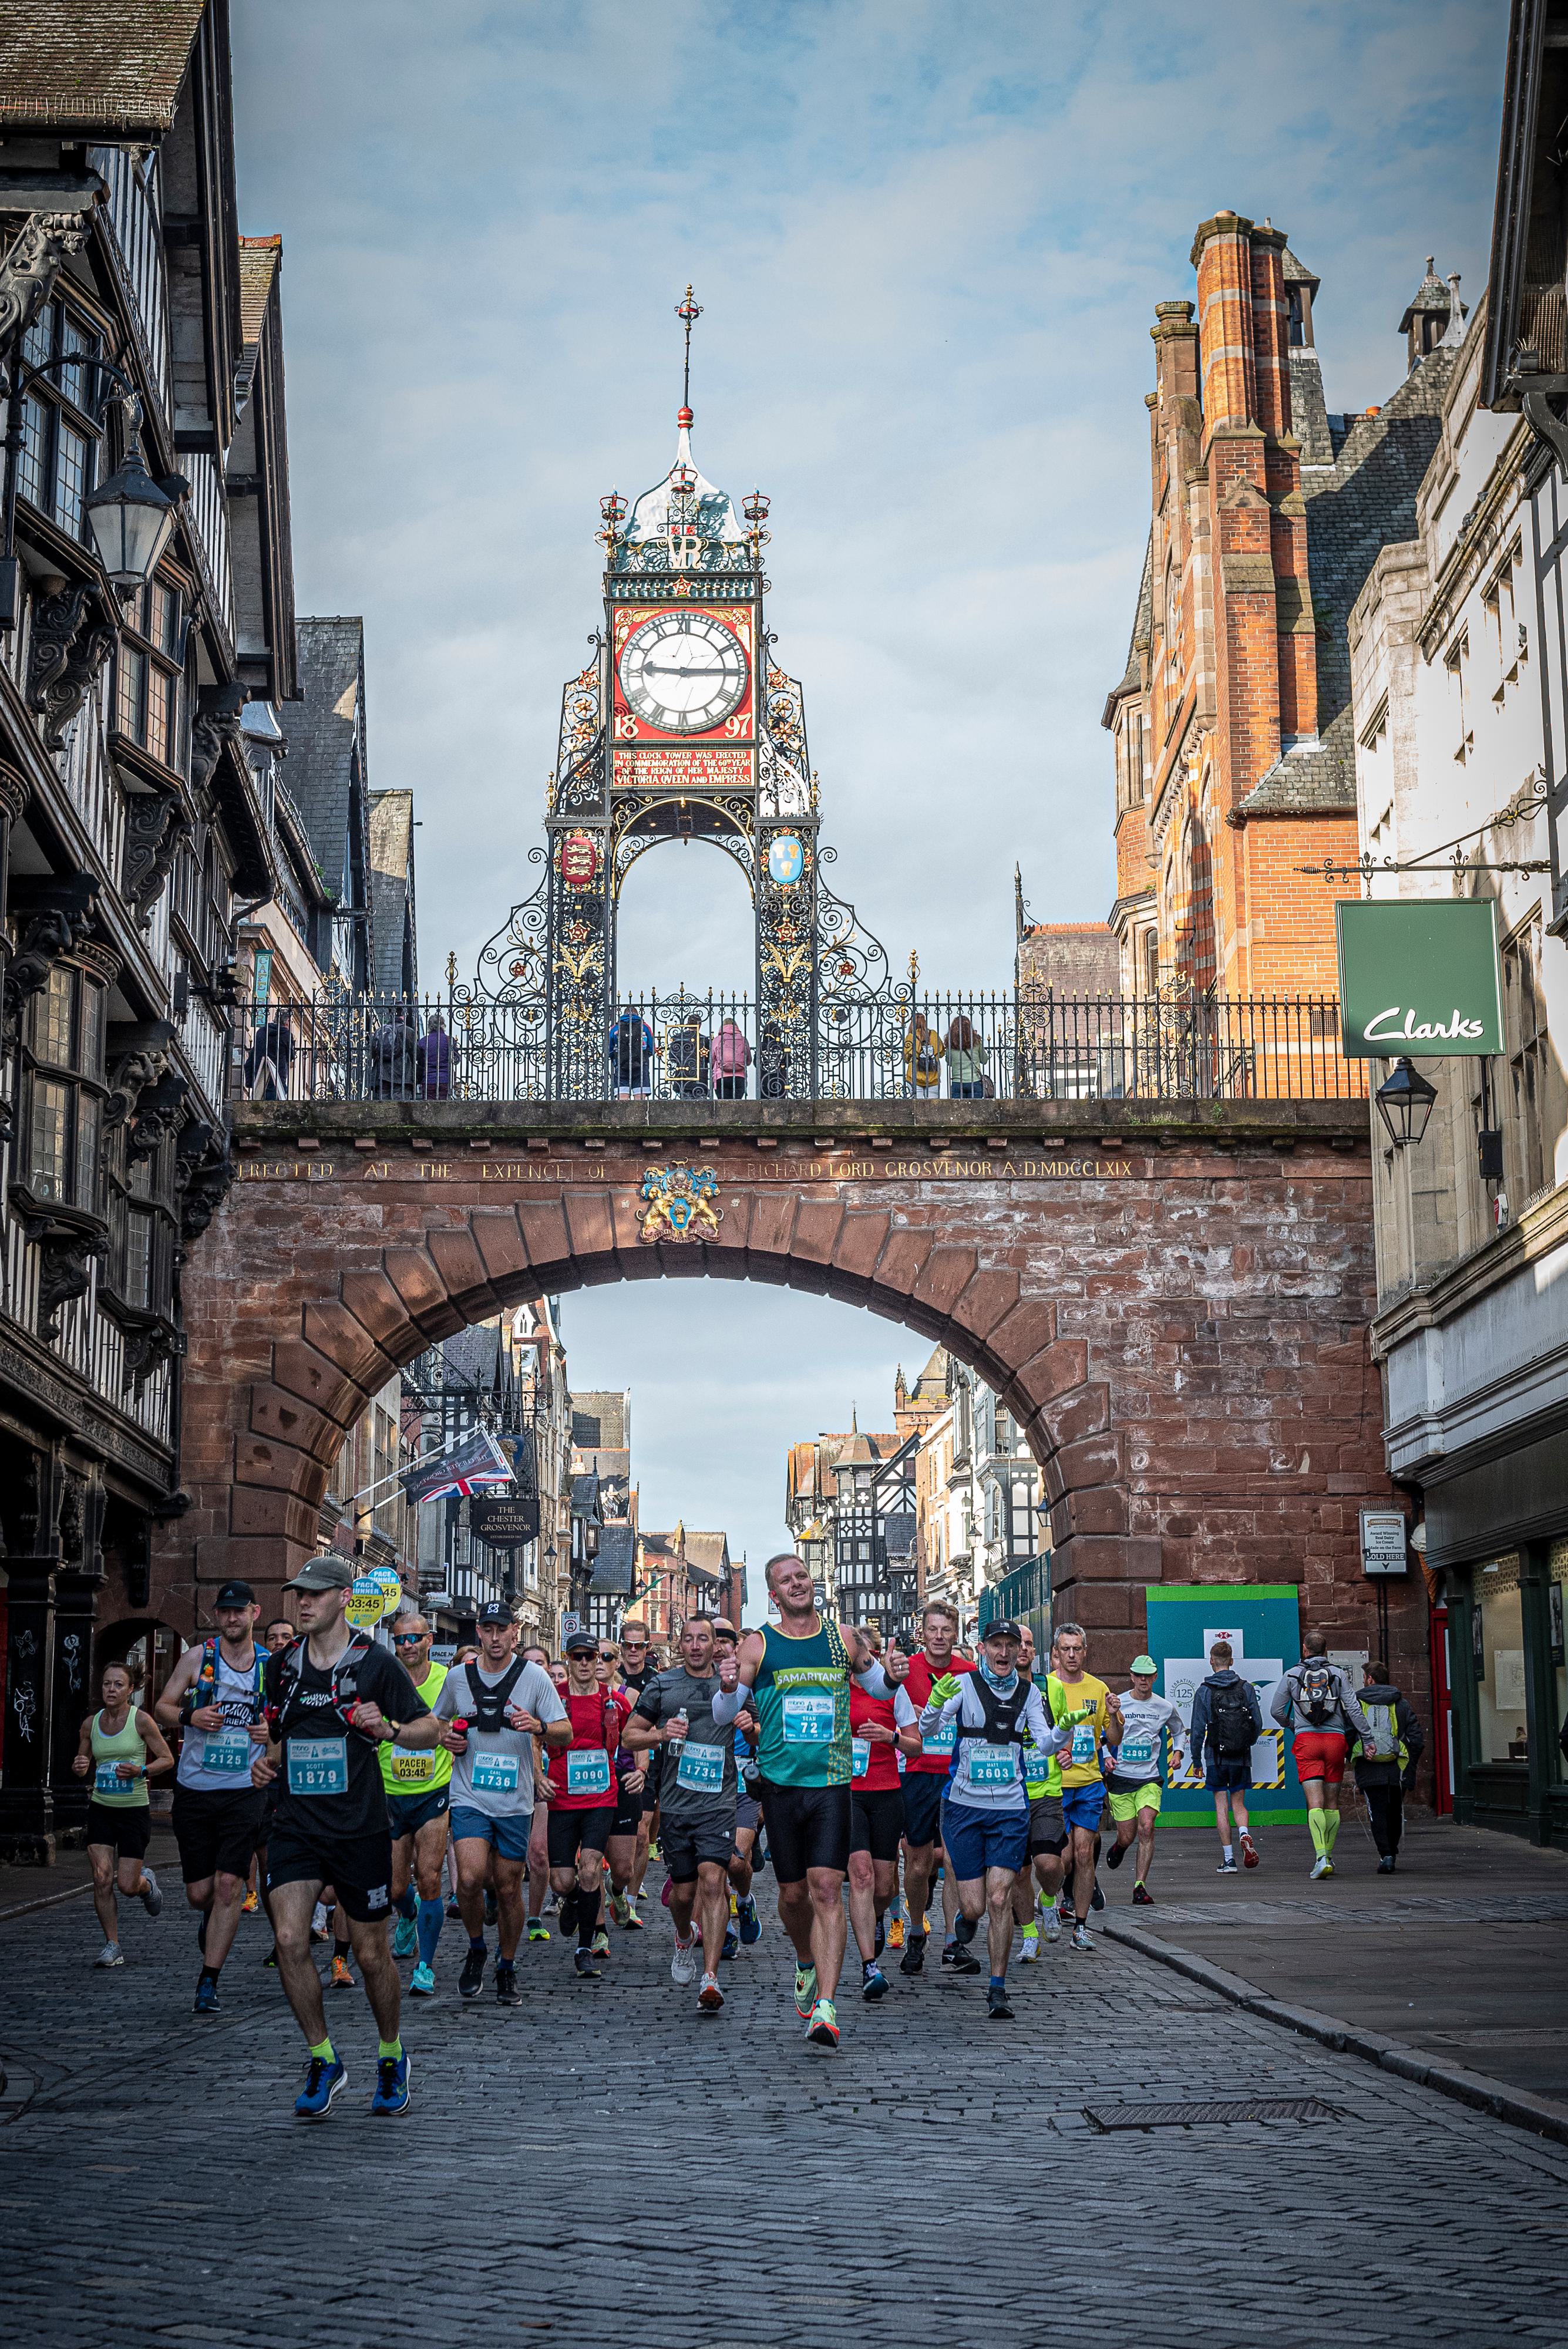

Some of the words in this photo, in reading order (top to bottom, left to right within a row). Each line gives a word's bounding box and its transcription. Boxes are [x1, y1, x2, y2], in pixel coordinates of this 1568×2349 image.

[715, 751, 747, 759] ERECTED
[1363, 1007, 1484, 1042] Clarks
[364, 1164, 393, 1177] AT
[416, 1164, 453, 1178] THE
[482, 1164, 566, 1179] EXPENCE
[748, 1162, 822, 1177] RICHARD
[829, 1162, 874, 1177] LORD
[885, 1162, 992, 1177] GROSVENOR
[348, 1598, 380, 1608] 03:45
[777, 1672, 843, 1685] SAMARITANS
[1169, 1678, 1196, 1698] CELEBRATING
[1176, 1689, 1193, 1698] 125
[800, 1722, 818, 1734] 72
[210, 1753, 241, 1765] 2125
[399, 1759, 426, 1768] PACER
[297, 1770, 337, 1784] 1879
[400, 1768, 425, 1777] 03:45
[575, 1769, 603, 1781] 3090
[977, 1768, 1008, 1779] 2603
[102, 1779, 127, 1788] 1418
[480, 1774, 510, 1787] 1736
